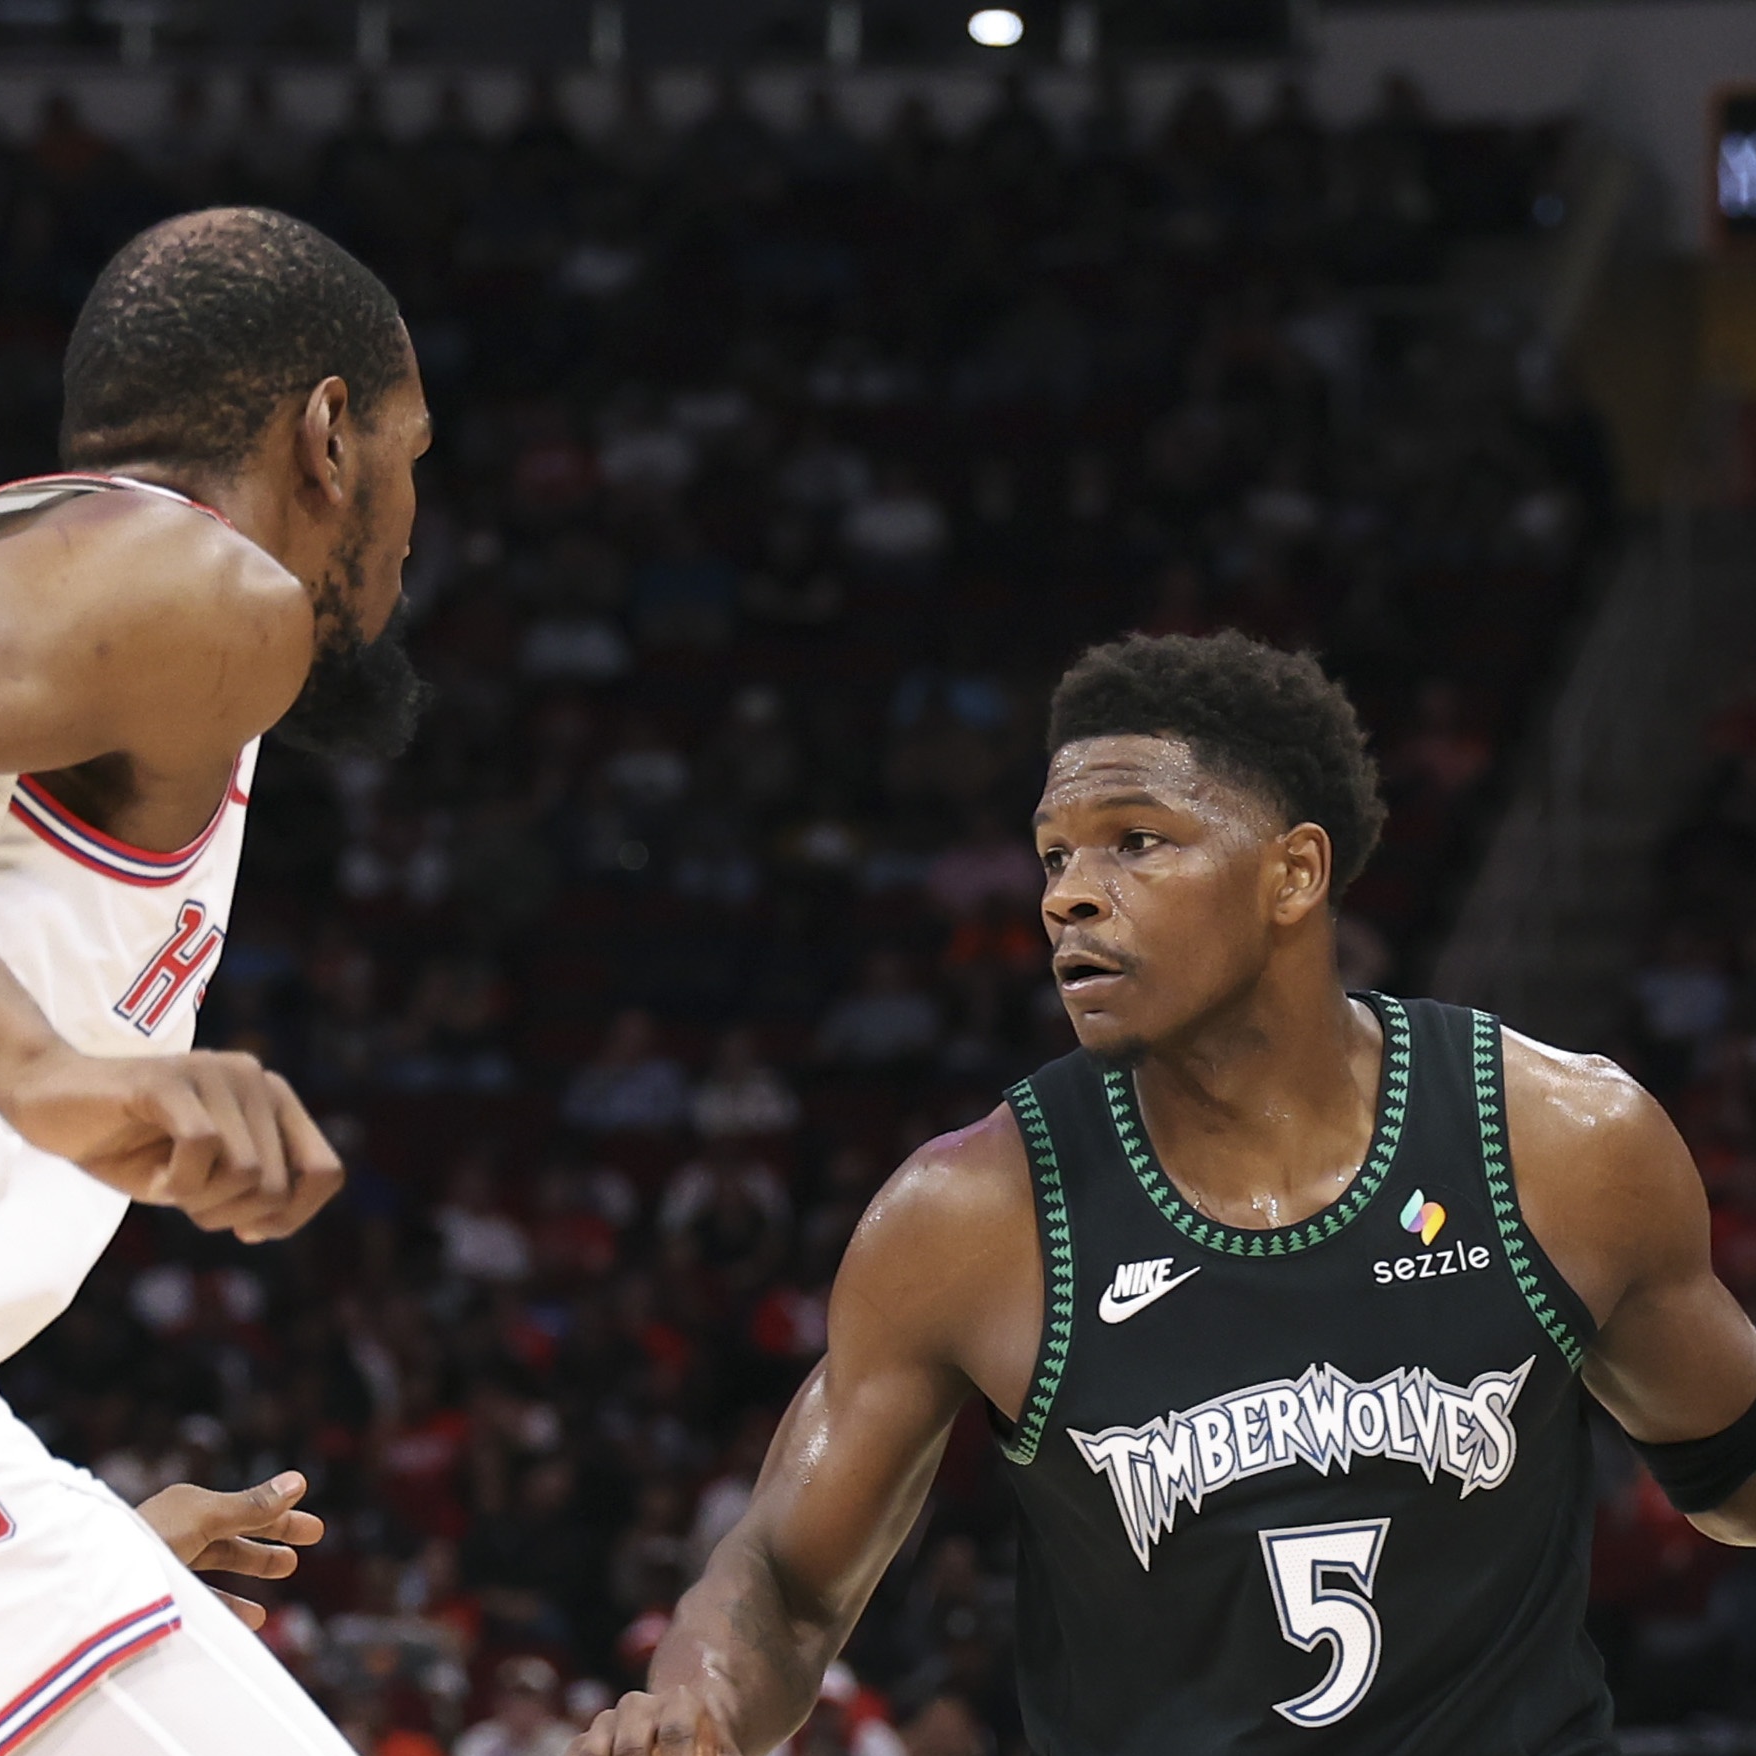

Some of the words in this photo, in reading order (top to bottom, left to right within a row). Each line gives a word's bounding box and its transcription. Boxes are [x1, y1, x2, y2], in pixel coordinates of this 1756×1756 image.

[114, 899, 225, 1036] H
[1112, 1257, 1174, 1299] NIKE
[1373, 1240, 1490, 1284] sezzle
[1066, 1355, 1536, 1571] TIMBERWOLVES
[1258, 1517, 1391, 1728] 5
